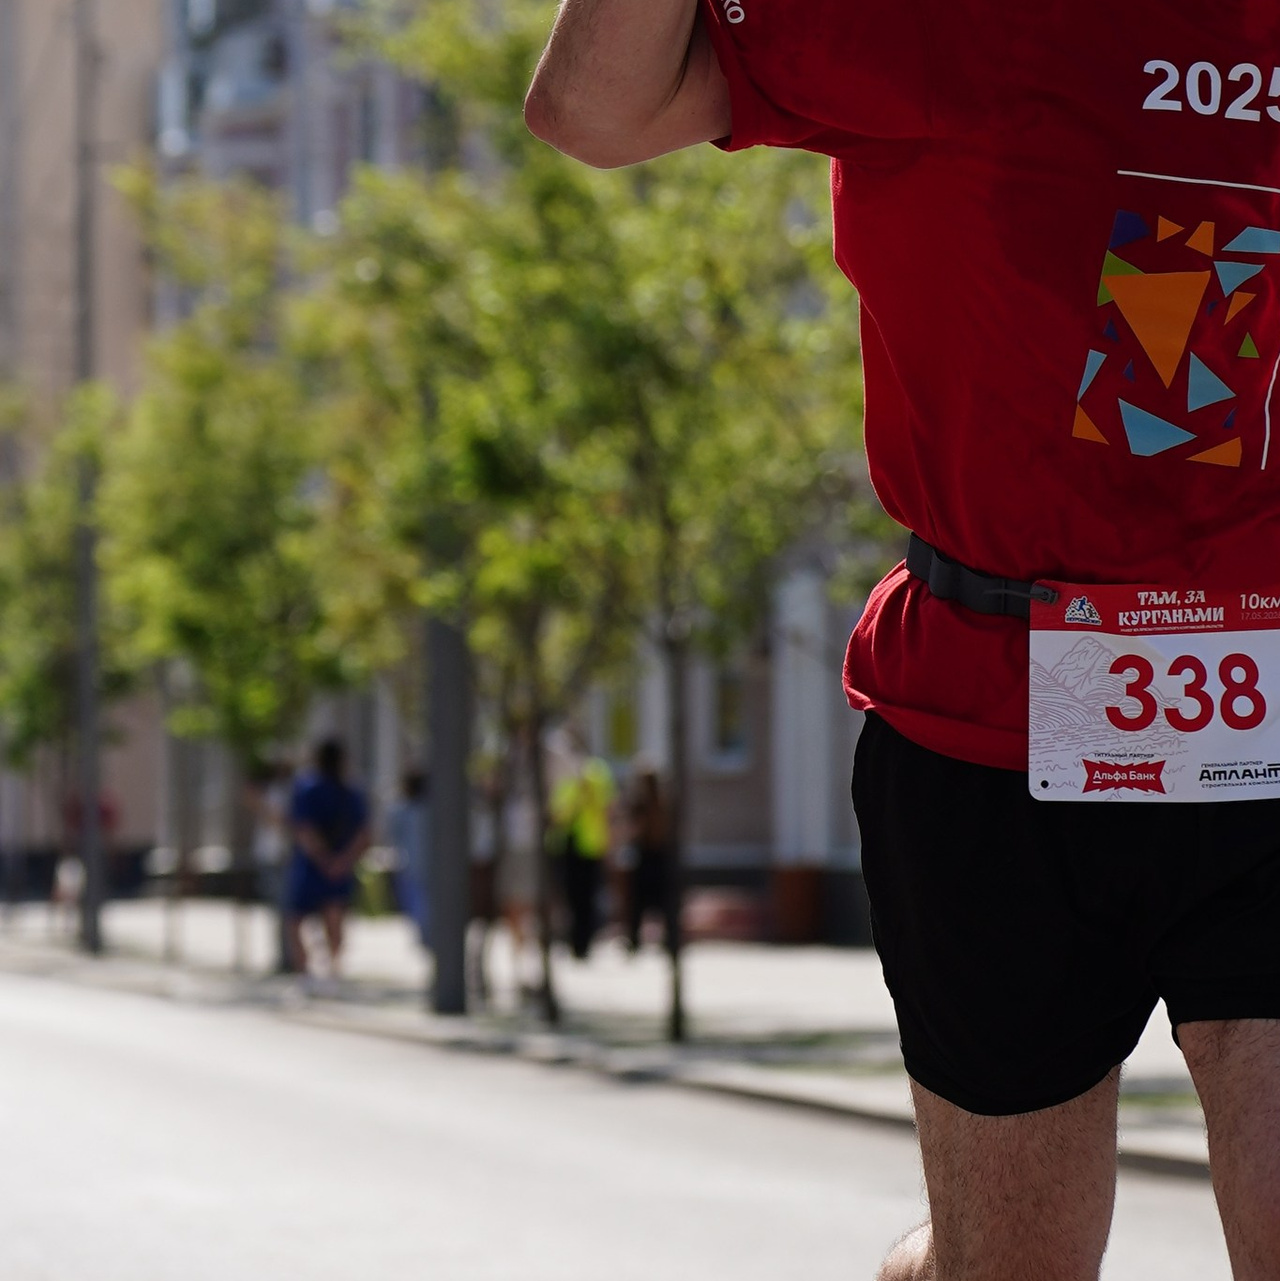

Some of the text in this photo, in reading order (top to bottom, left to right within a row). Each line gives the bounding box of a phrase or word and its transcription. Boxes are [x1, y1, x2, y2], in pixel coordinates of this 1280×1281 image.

[1137, 590, 1206, 607] ТАМ, ЗА
[1118, 606, 1225, 626] КУРГАНАМИ
[1105, 653, 1267, 733] 338
[1092, 770, 1156, 783] Альфа Банк
